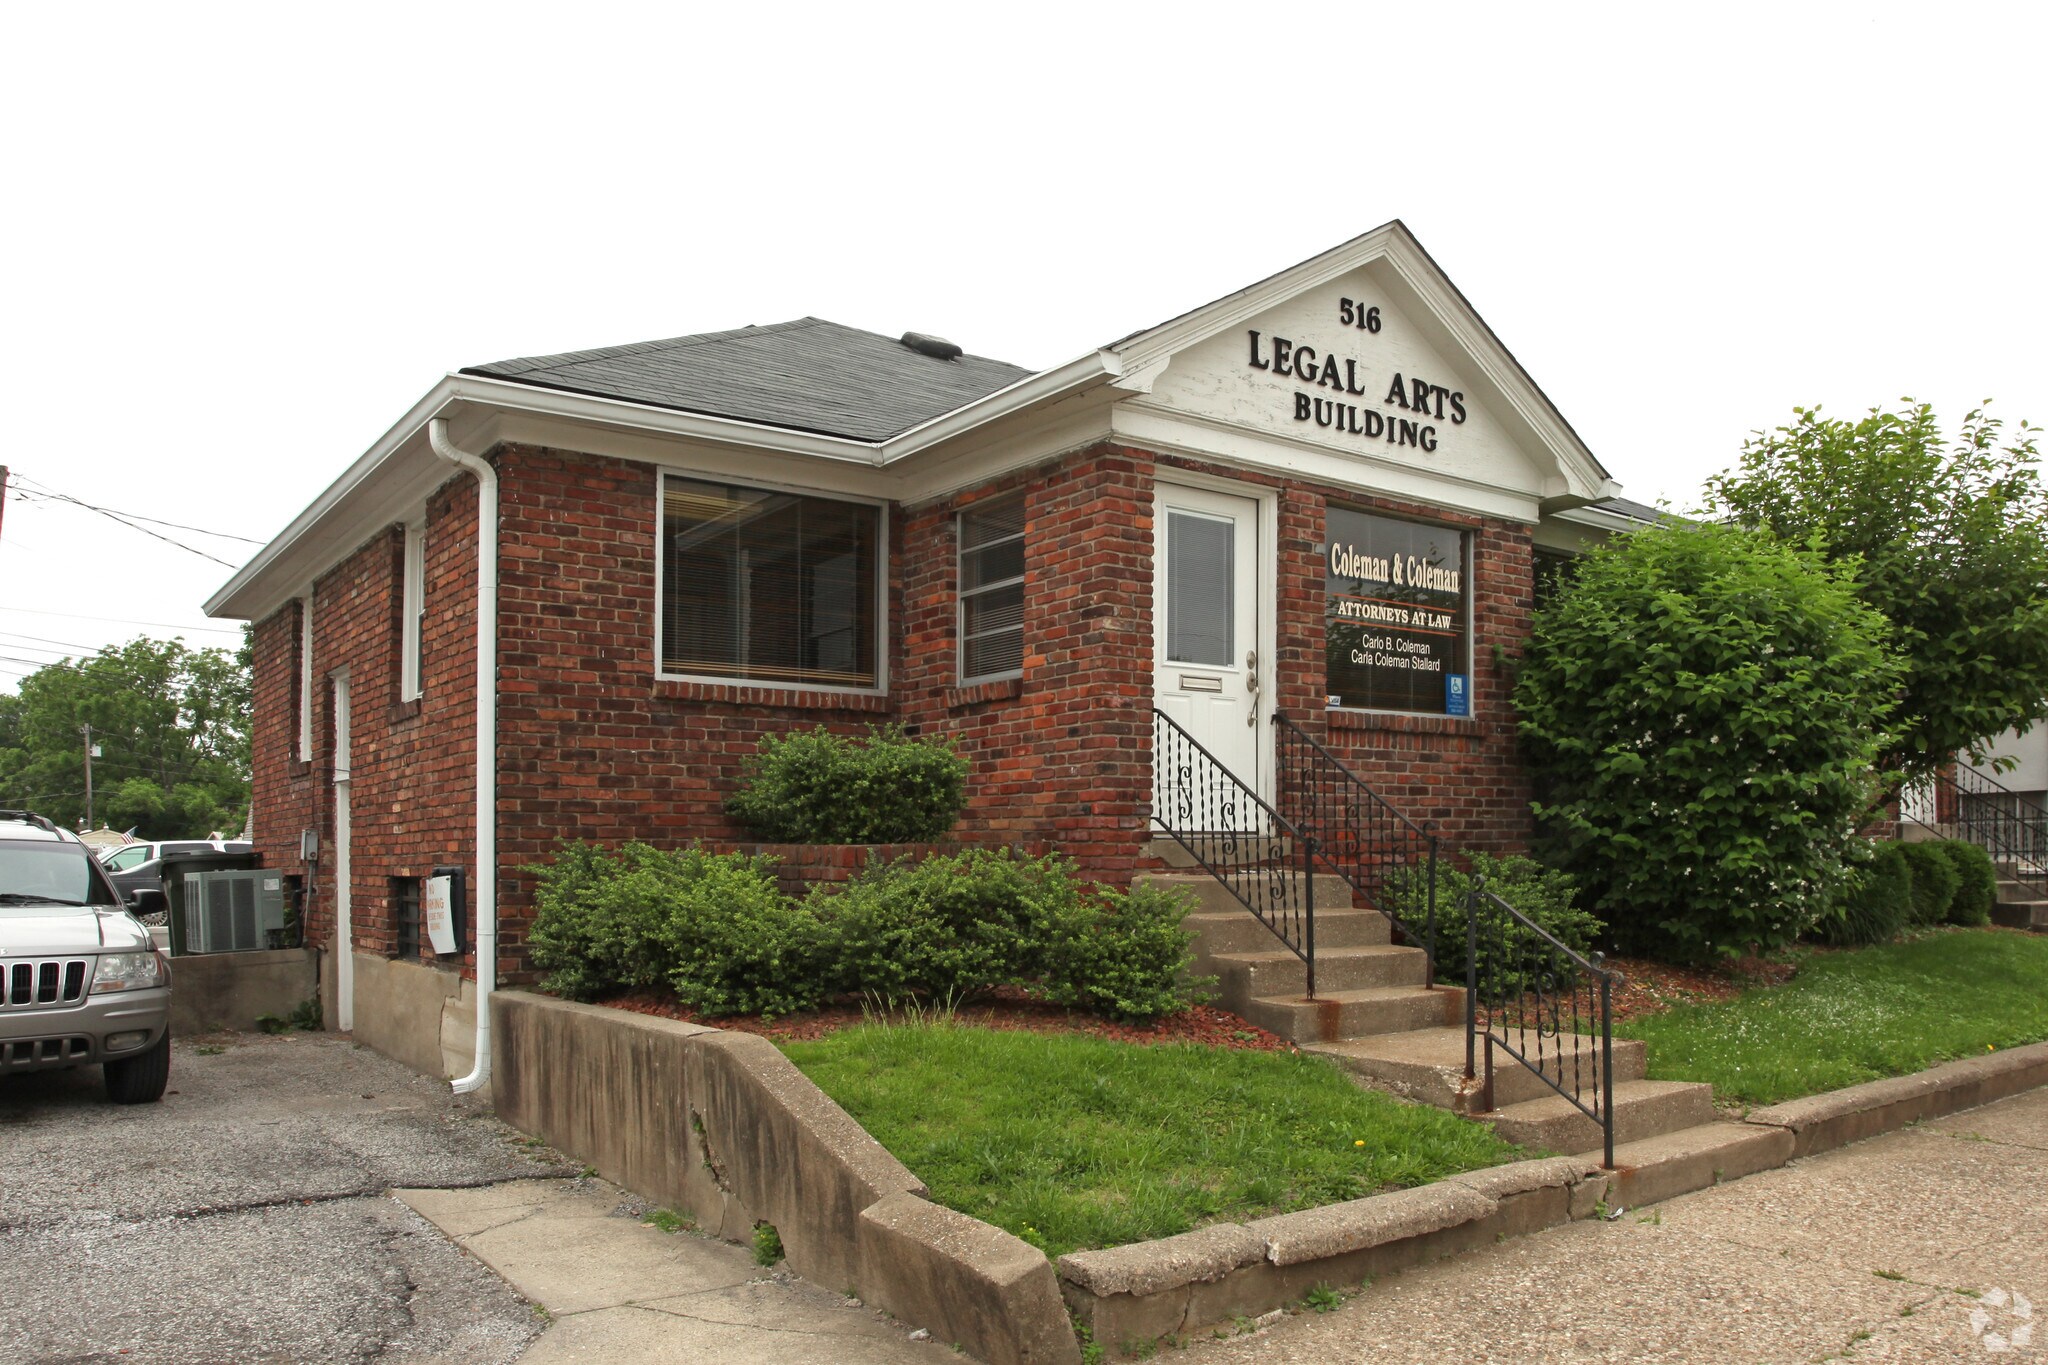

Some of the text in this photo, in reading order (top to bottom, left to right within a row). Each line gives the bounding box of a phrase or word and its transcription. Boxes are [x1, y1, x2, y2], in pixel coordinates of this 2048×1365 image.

[1340, 297, 1382, 334] 516
[1248, 330, 1467, 425] LEGAL ARTS
[1293, 391, 1438, 452] BUILDING
[1331, 542, 1460, 593] Coleman & Coleman
[1337, 600, 1452, 629] ATTORNEYS AT LAW
[1351, 649, 1441, 672] Carla Coleman Stallard
[1362, 633, 1431, 655] Carlo B. Coleman
